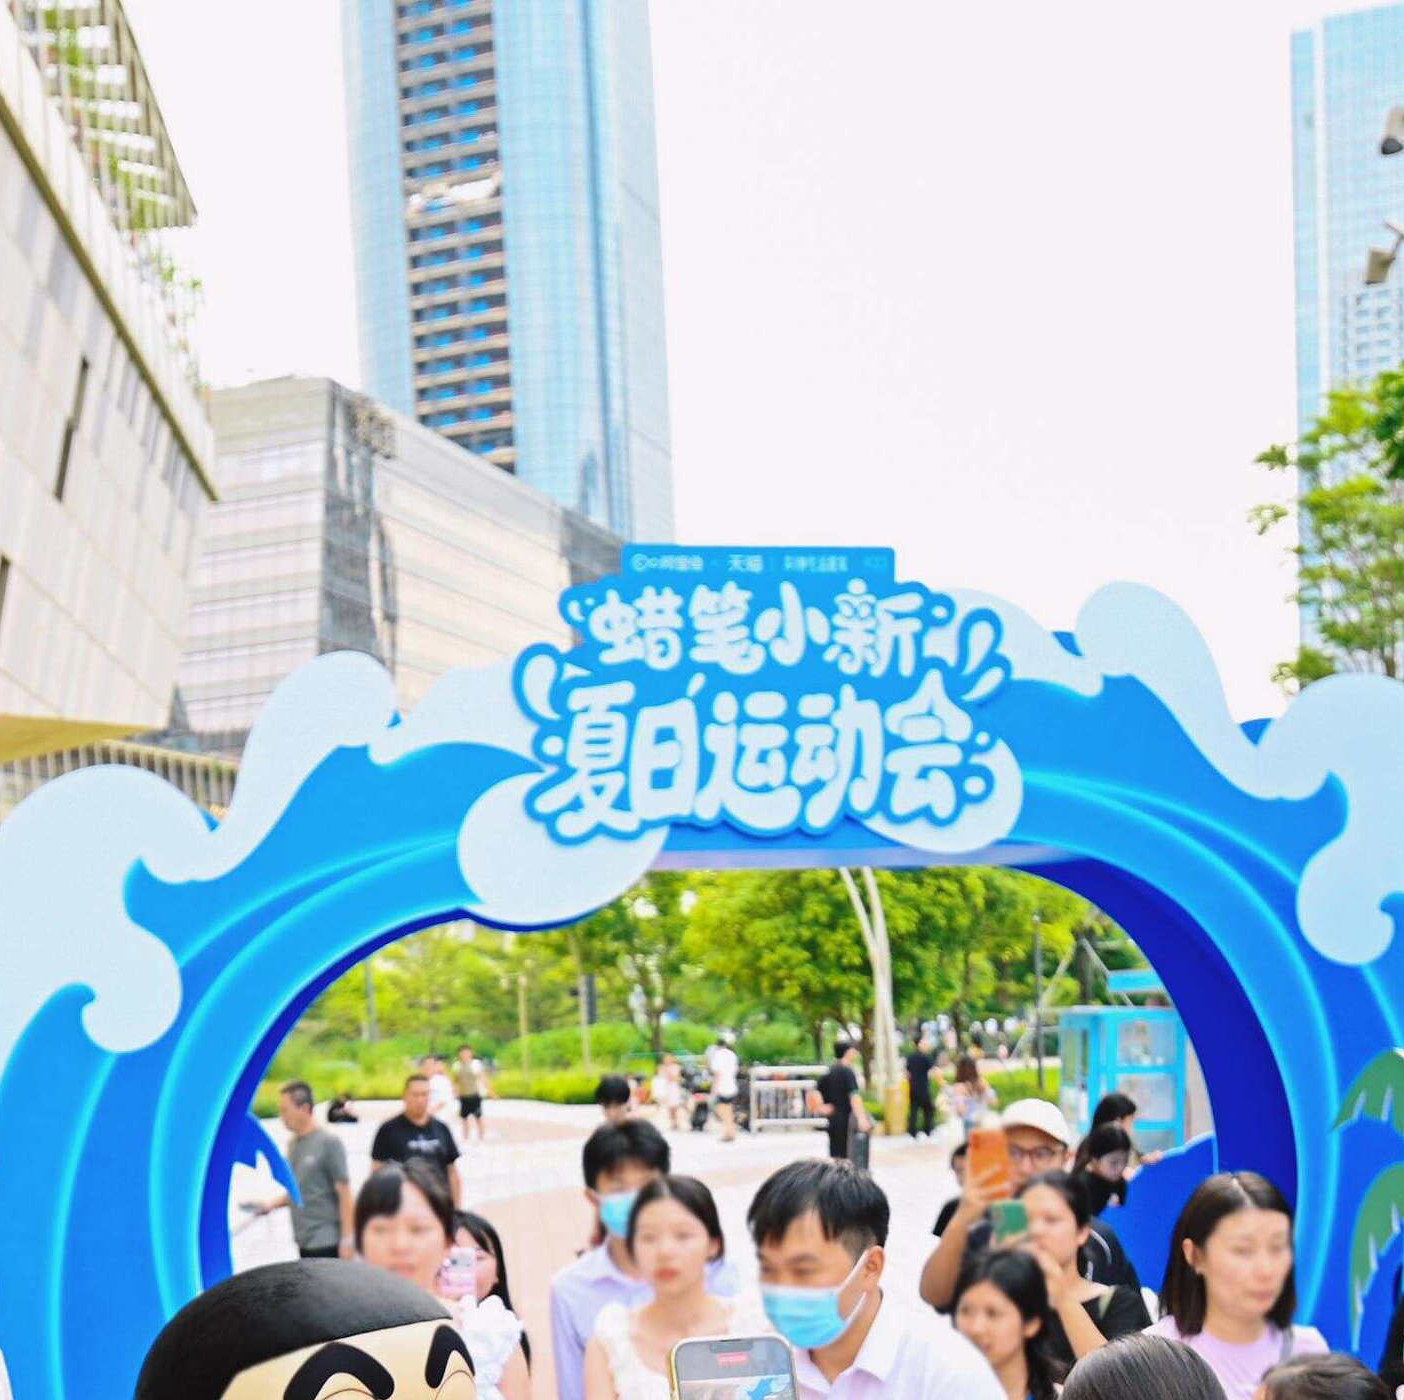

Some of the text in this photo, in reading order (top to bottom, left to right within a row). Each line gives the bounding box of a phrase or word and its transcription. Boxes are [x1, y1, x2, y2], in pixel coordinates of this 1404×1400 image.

[589, 578, 922, 677] 蜡笔小新
[533, 669, 973, 838] 夏日运动会
